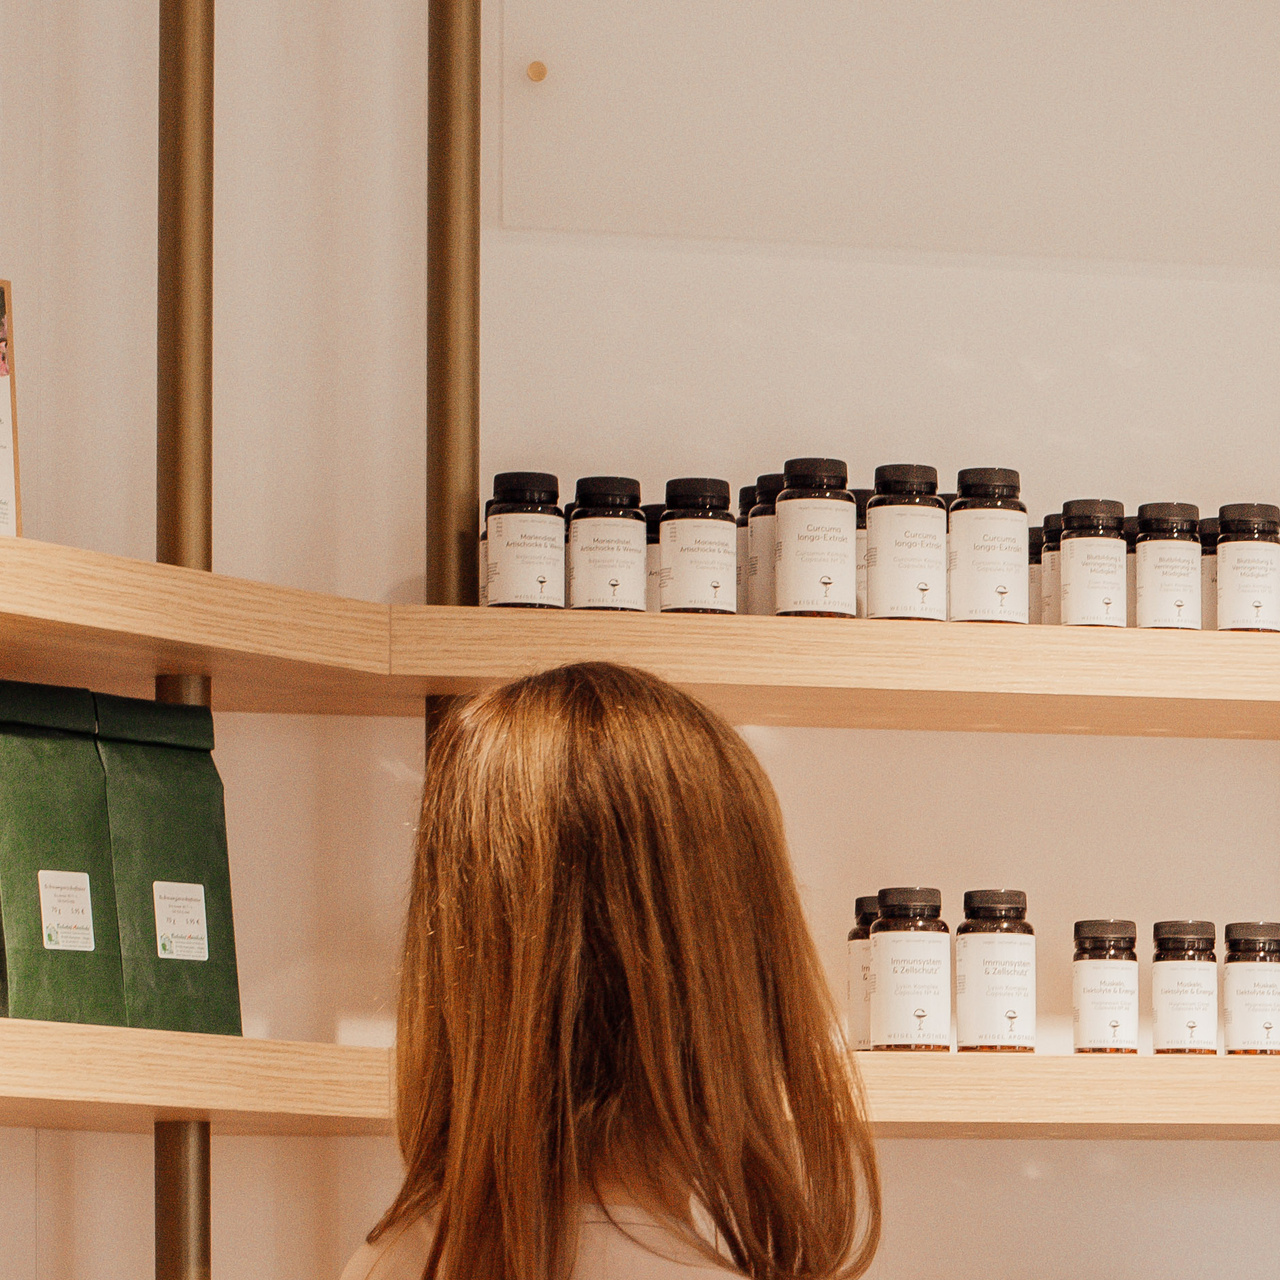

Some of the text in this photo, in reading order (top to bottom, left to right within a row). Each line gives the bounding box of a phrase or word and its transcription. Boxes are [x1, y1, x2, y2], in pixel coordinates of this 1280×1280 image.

[806, 523, 842, 533] Curcuma
[904, 530, 937, 541] Curcuma
[982, 533, 1017, 544] Curcuma
[891, 957, 942, 969] Immunsystem
